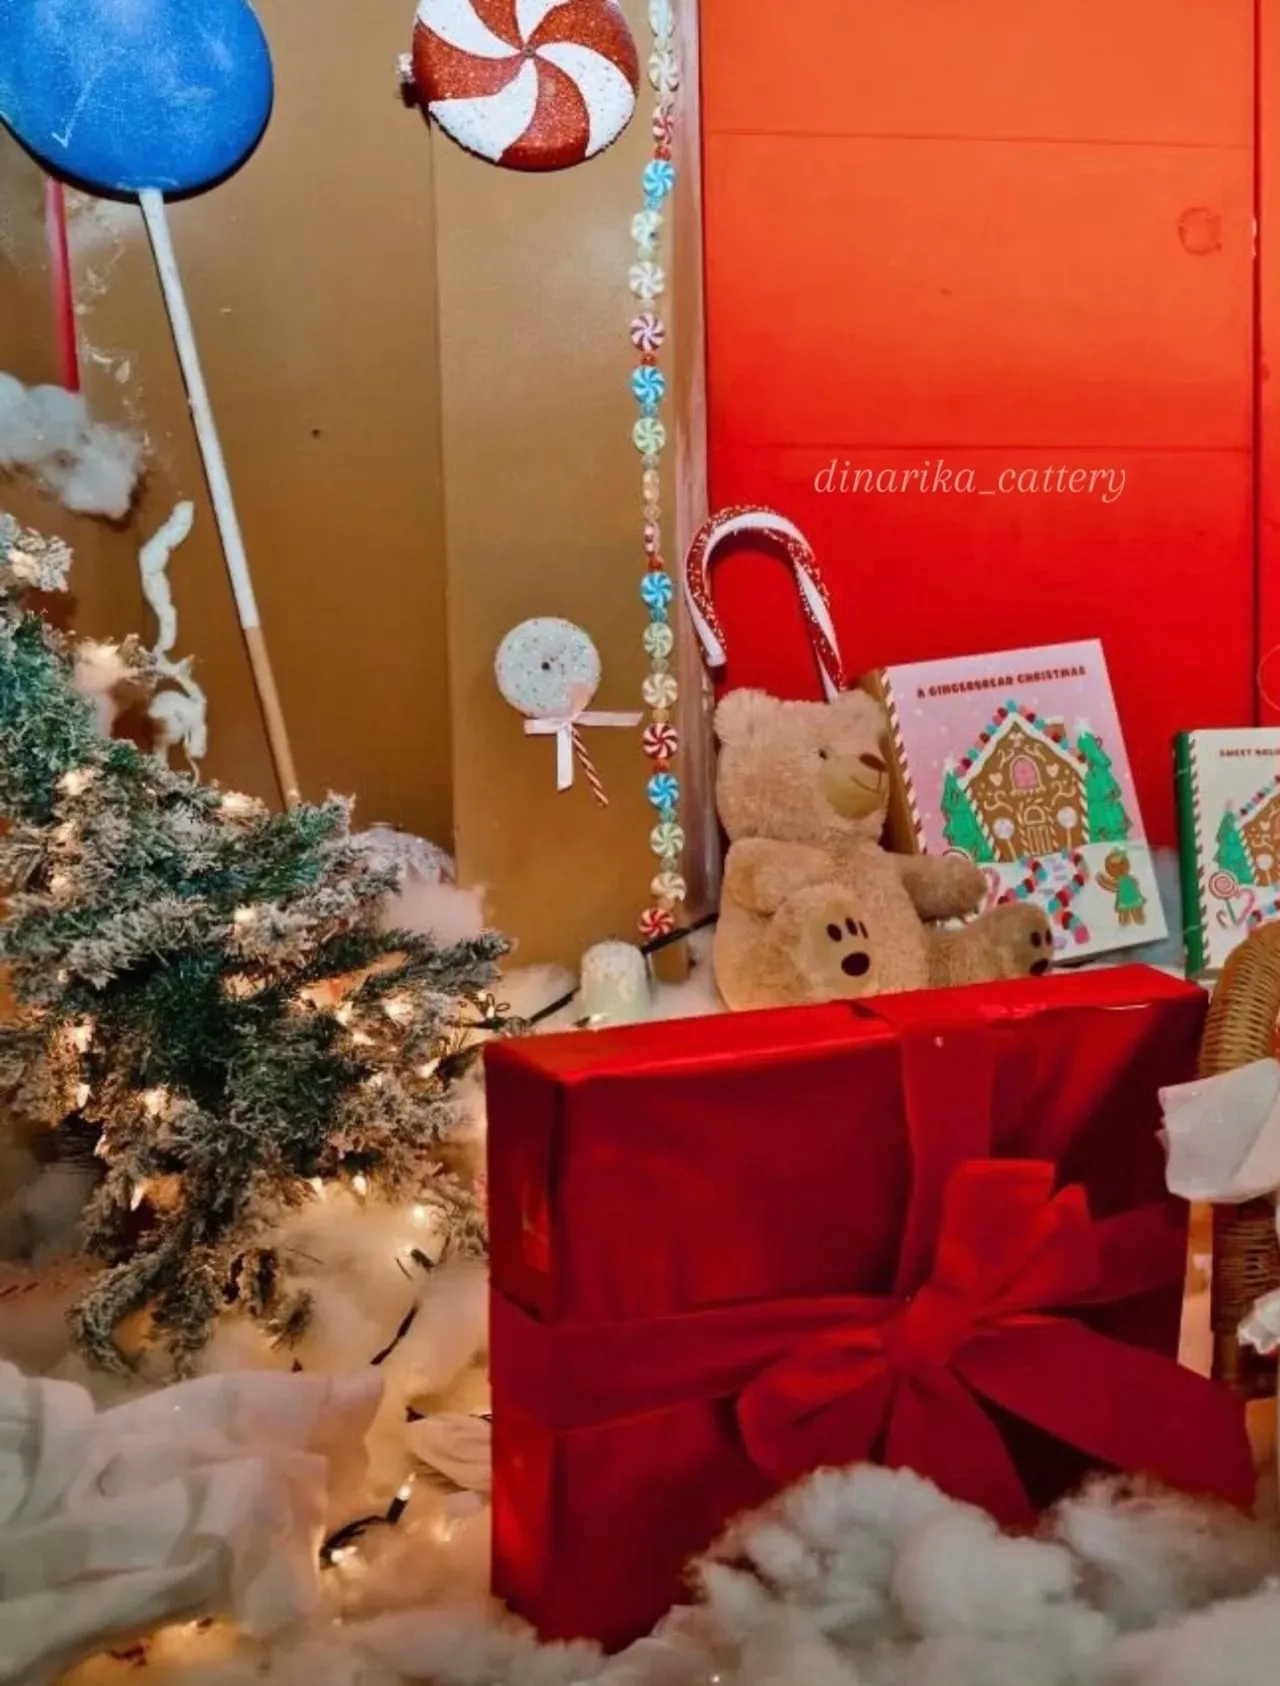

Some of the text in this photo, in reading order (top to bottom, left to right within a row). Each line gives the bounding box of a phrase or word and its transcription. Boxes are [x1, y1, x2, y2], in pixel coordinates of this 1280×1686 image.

[916, 665, 1087, 699] A GINGERBREAD CHRISTMAS
